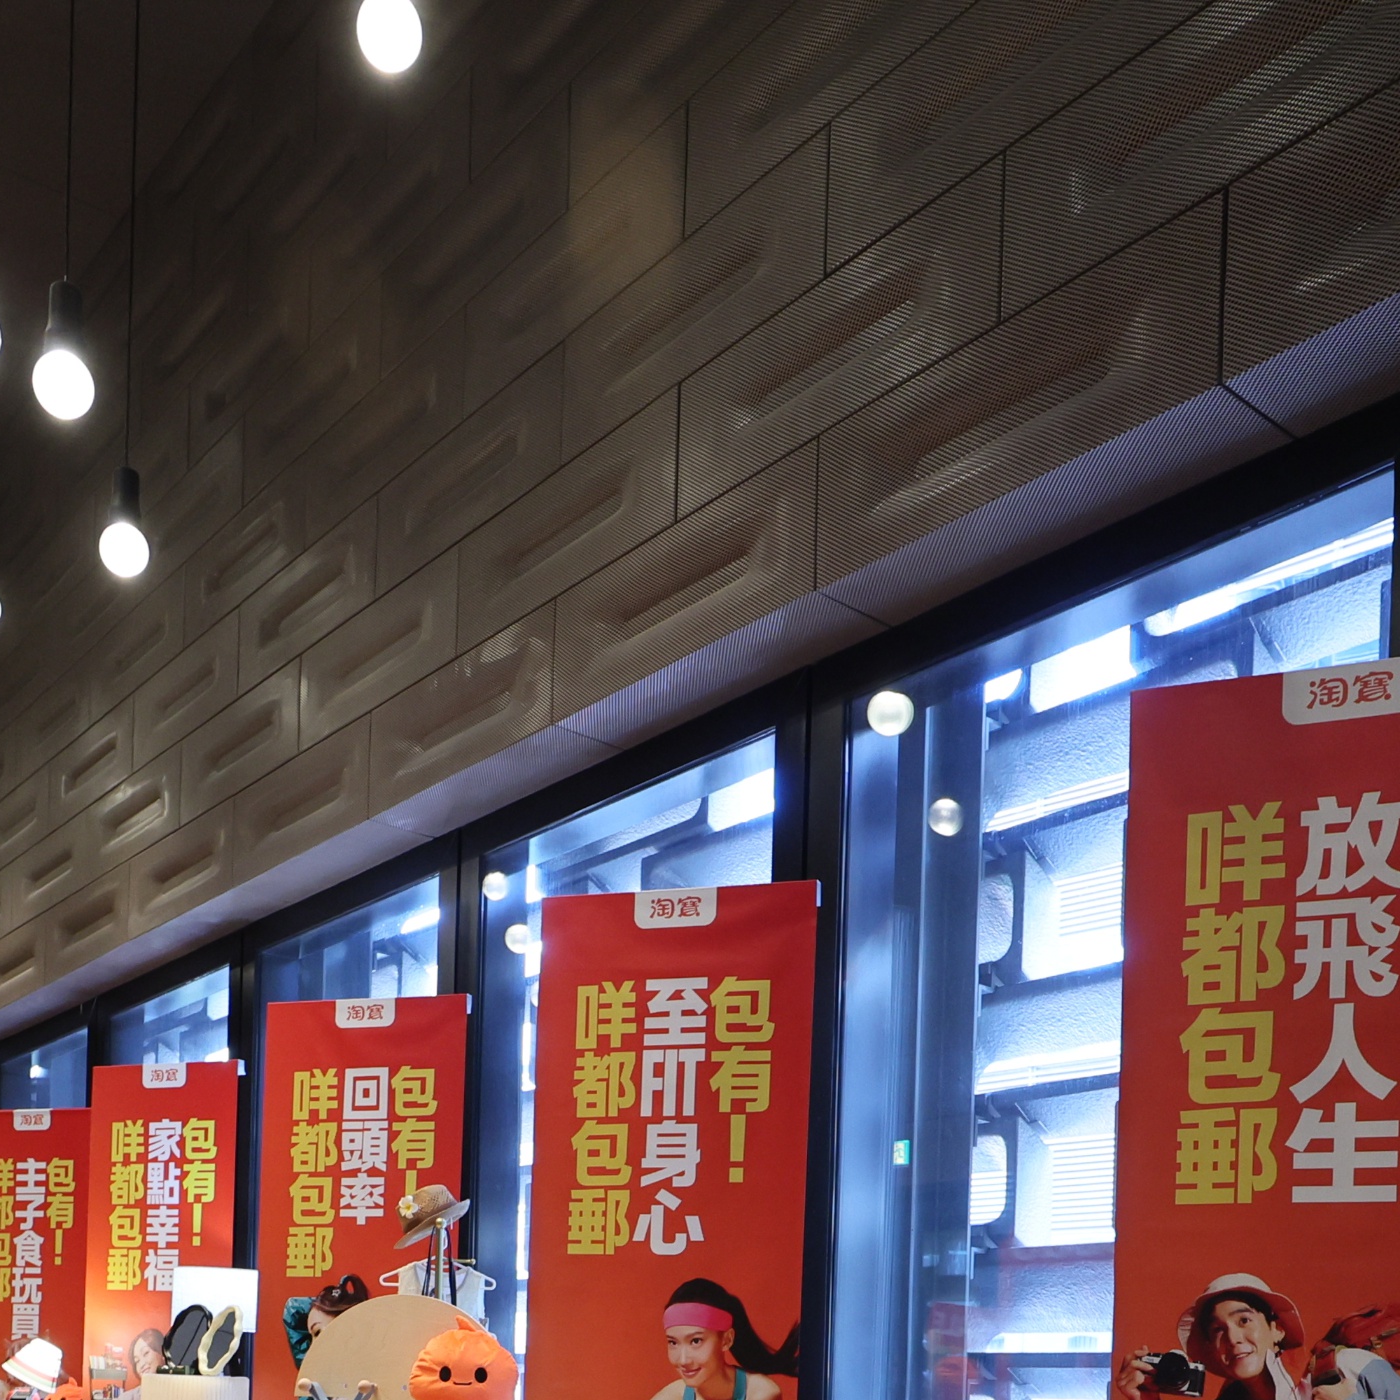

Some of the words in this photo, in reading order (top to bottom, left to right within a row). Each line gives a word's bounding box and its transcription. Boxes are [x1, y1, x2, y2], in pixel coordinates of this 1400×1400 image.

[1306, 671, 1396, 710] 淘寶
[649, 896, 702, 920] 淘寶
[150, 1068, 179, 1083] 淘寶
[346, 1004, 384, 1022] 淘寶
[709, 976, 775, 1183] 包有!
[1175, 801, 1287, 1205] 咩都包郵
[182, 1117, 218, 1247] 包有!
[285, 1068, 338, 1278] 咩都包郵
[339, 1066, 390, 1226] 回頭率
[567, 980, 637, 1256] 咩都包郵
[11, 1157, 47, 1341] 主子食玩買
[46, 1157, 76, 1266] 包有!
[105, 1119, 145, 1291] 咩都包郵
[144, 1118, 182, 1292] 家點幸福
